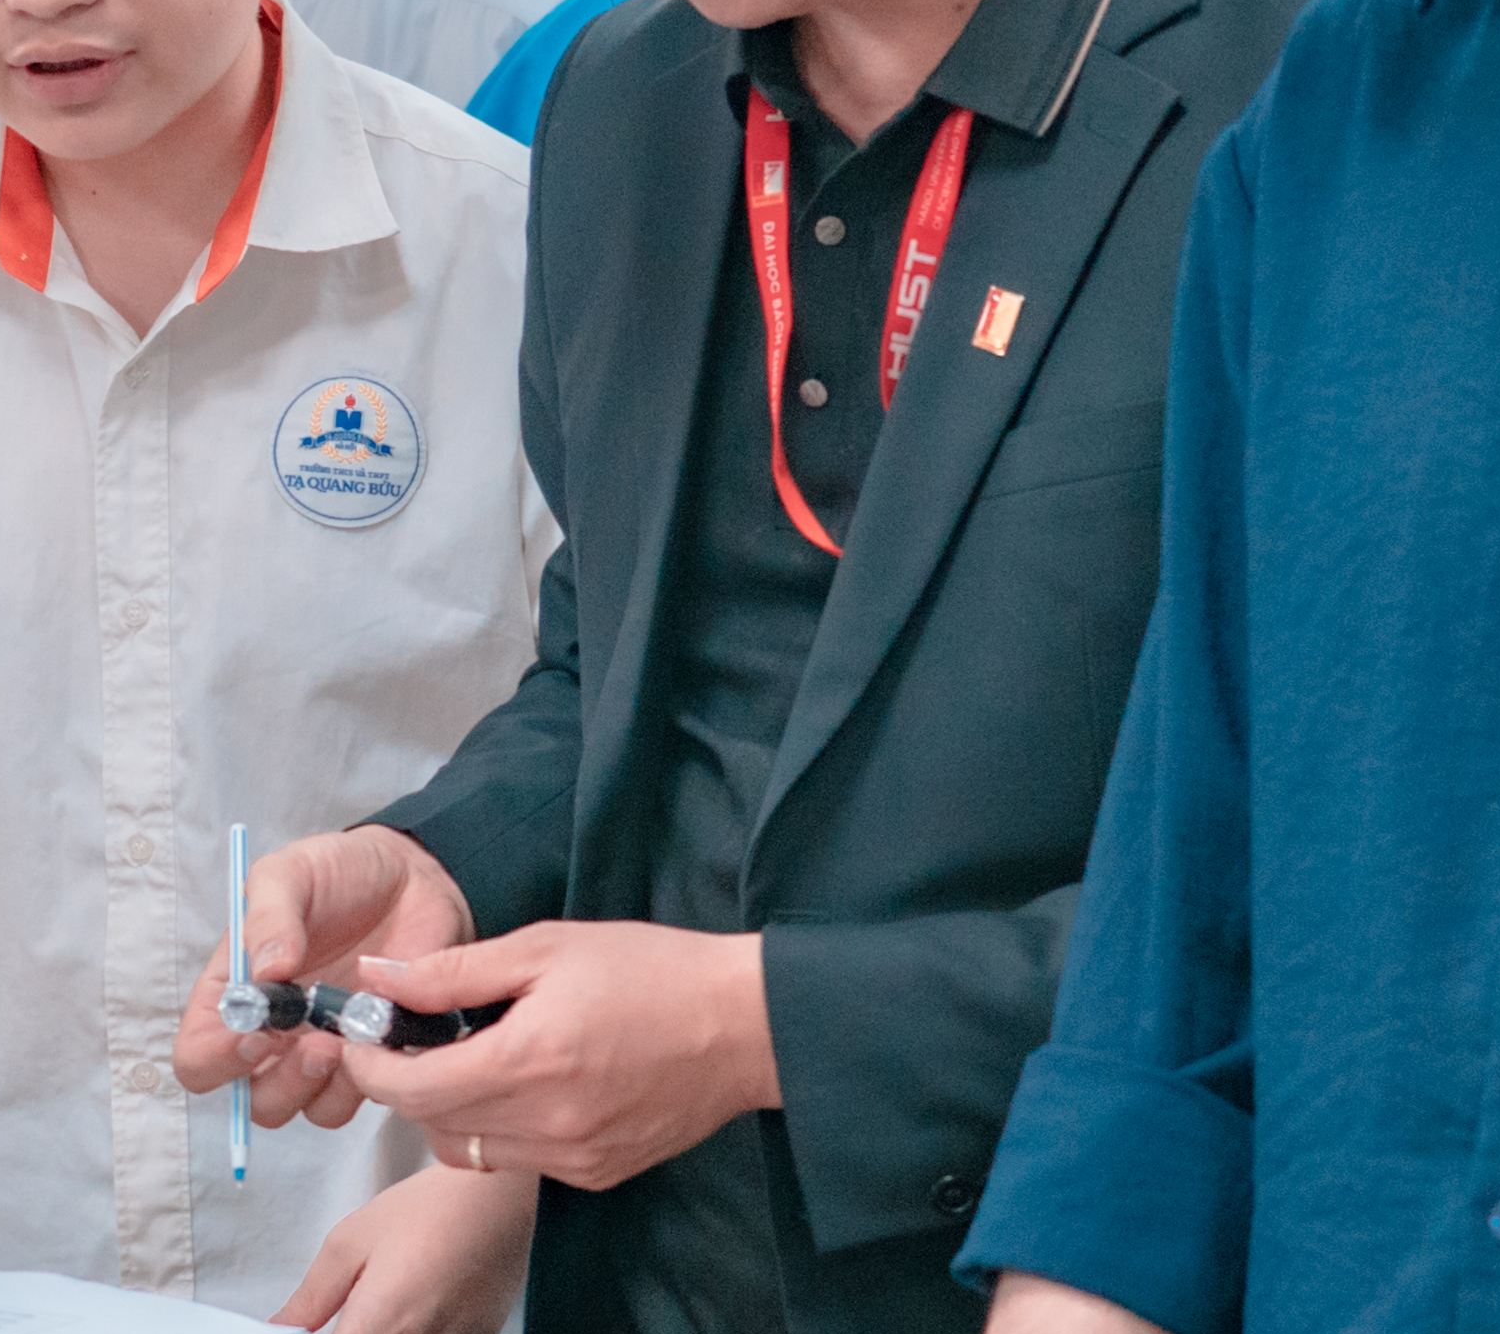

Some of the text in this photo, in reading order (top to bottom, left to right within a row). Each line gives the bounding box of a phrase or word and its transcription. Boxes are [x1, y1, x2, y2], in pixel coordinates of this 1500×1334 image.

[887, 239, 937, 380] HUST
[285, 474, 305, 491] TẠ
[307, 476, 366, 493] QUANG
